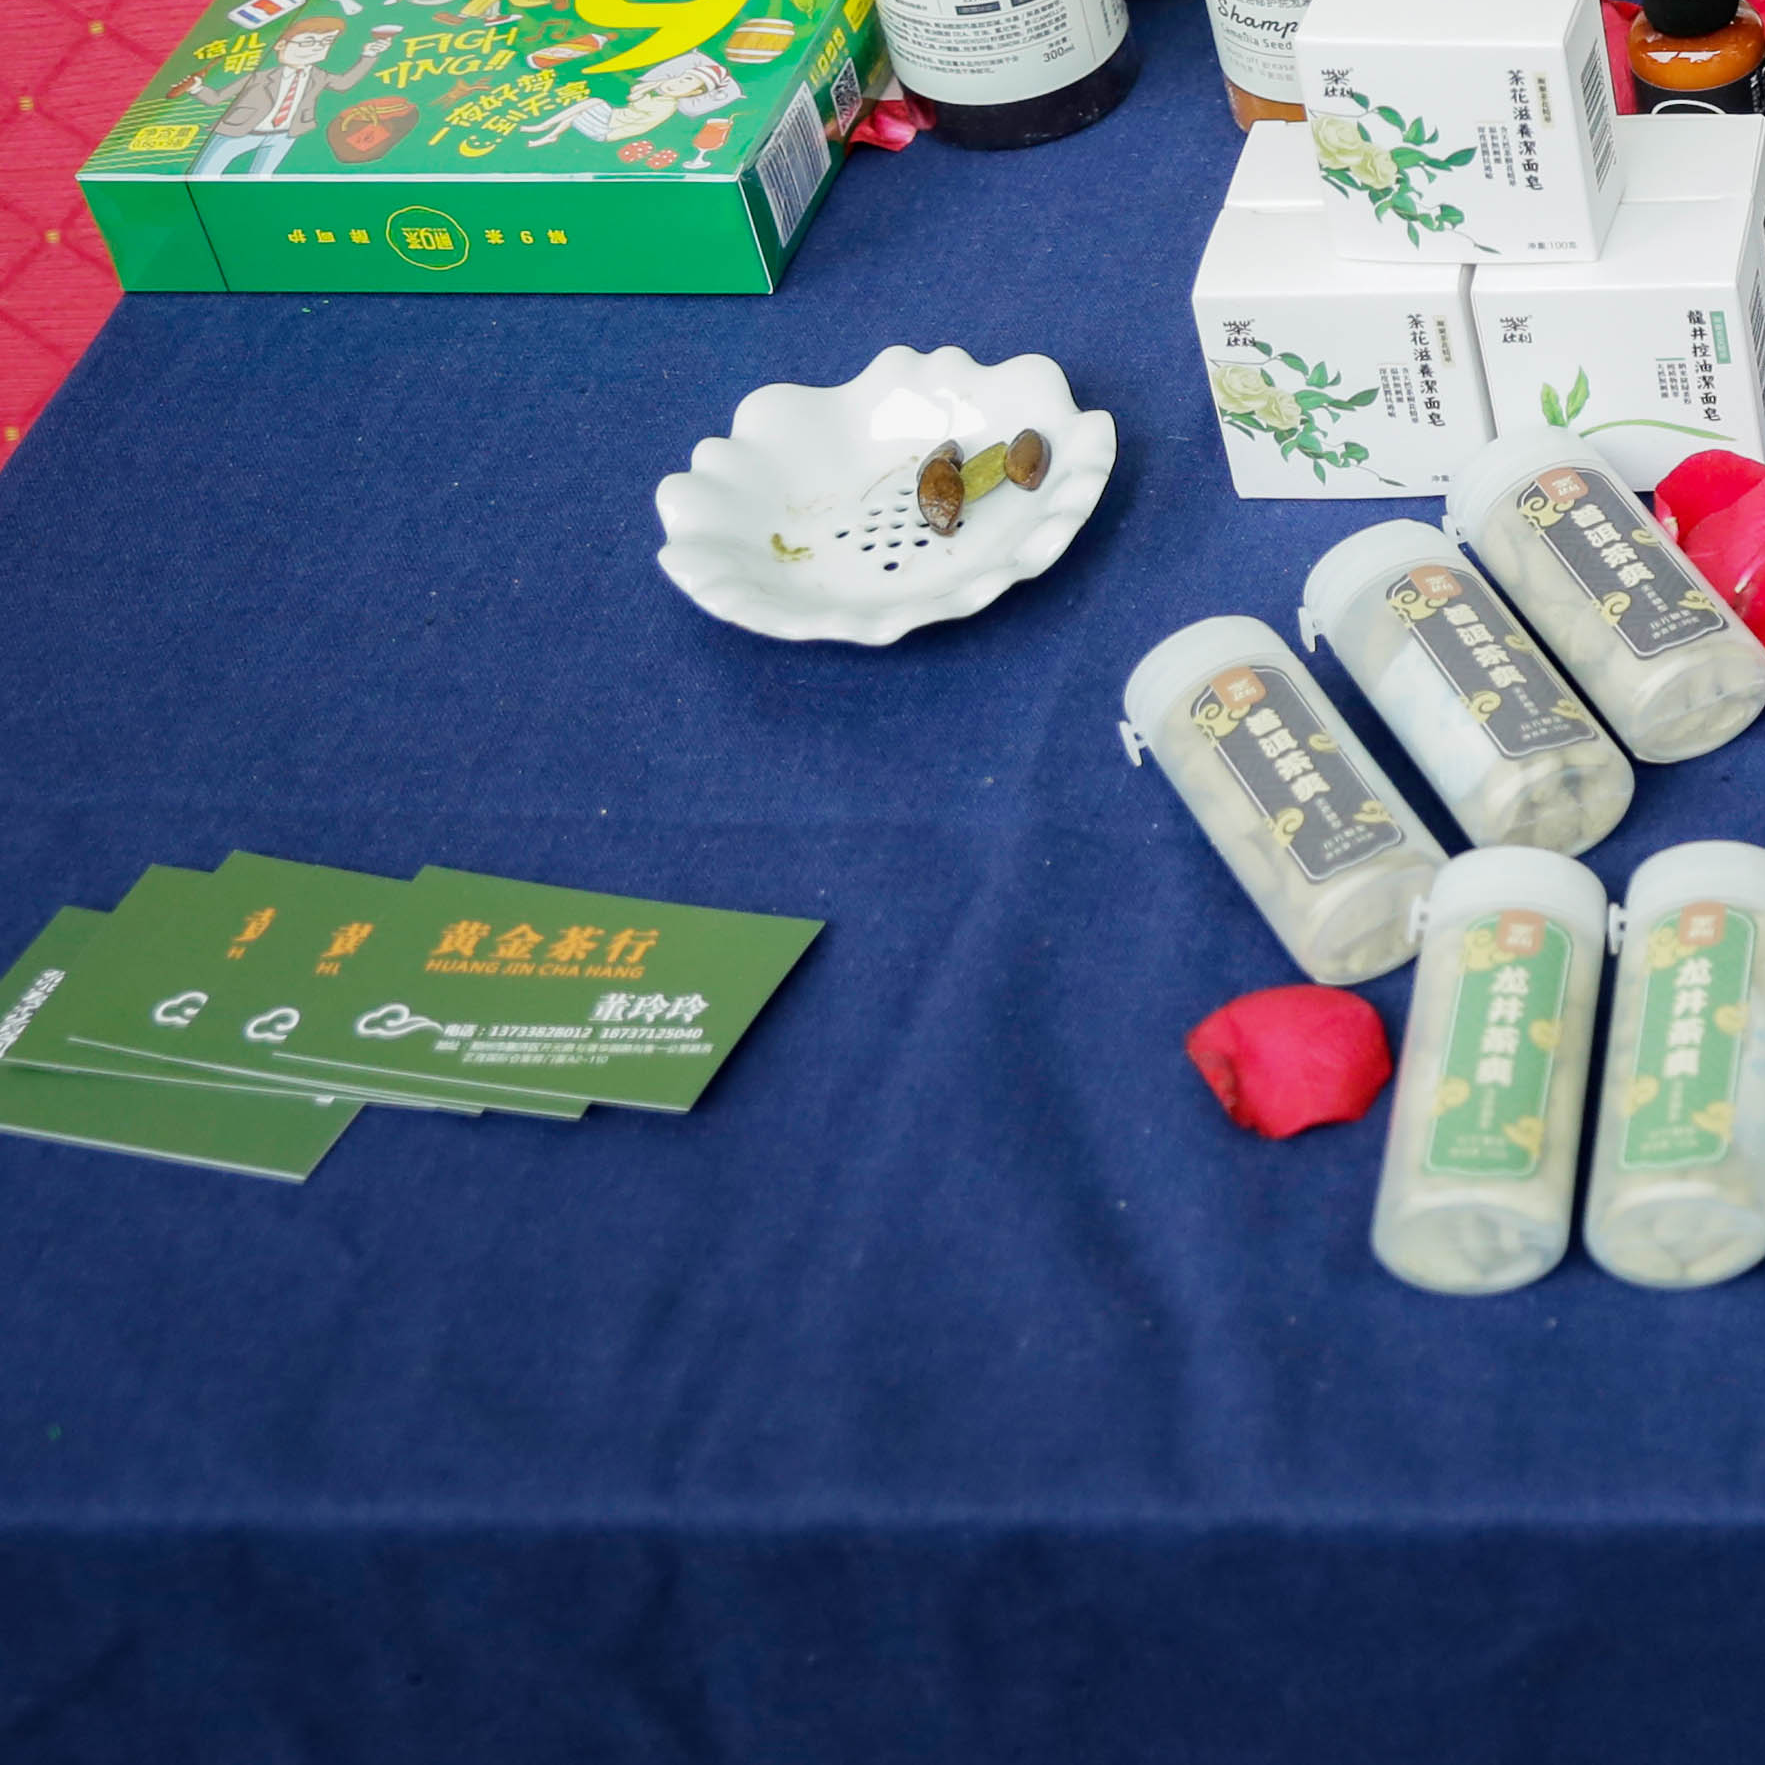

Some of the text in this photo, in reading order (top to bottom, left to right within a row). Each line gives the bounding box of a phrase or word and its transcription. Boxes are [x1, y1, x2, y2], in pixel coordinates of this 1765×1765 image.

[403, 27, 519, 57] FIGH
[430, 920, 660, 964] 黄金茶行
[425, 959, 644, 979] HUANG JIN CHA HANG
